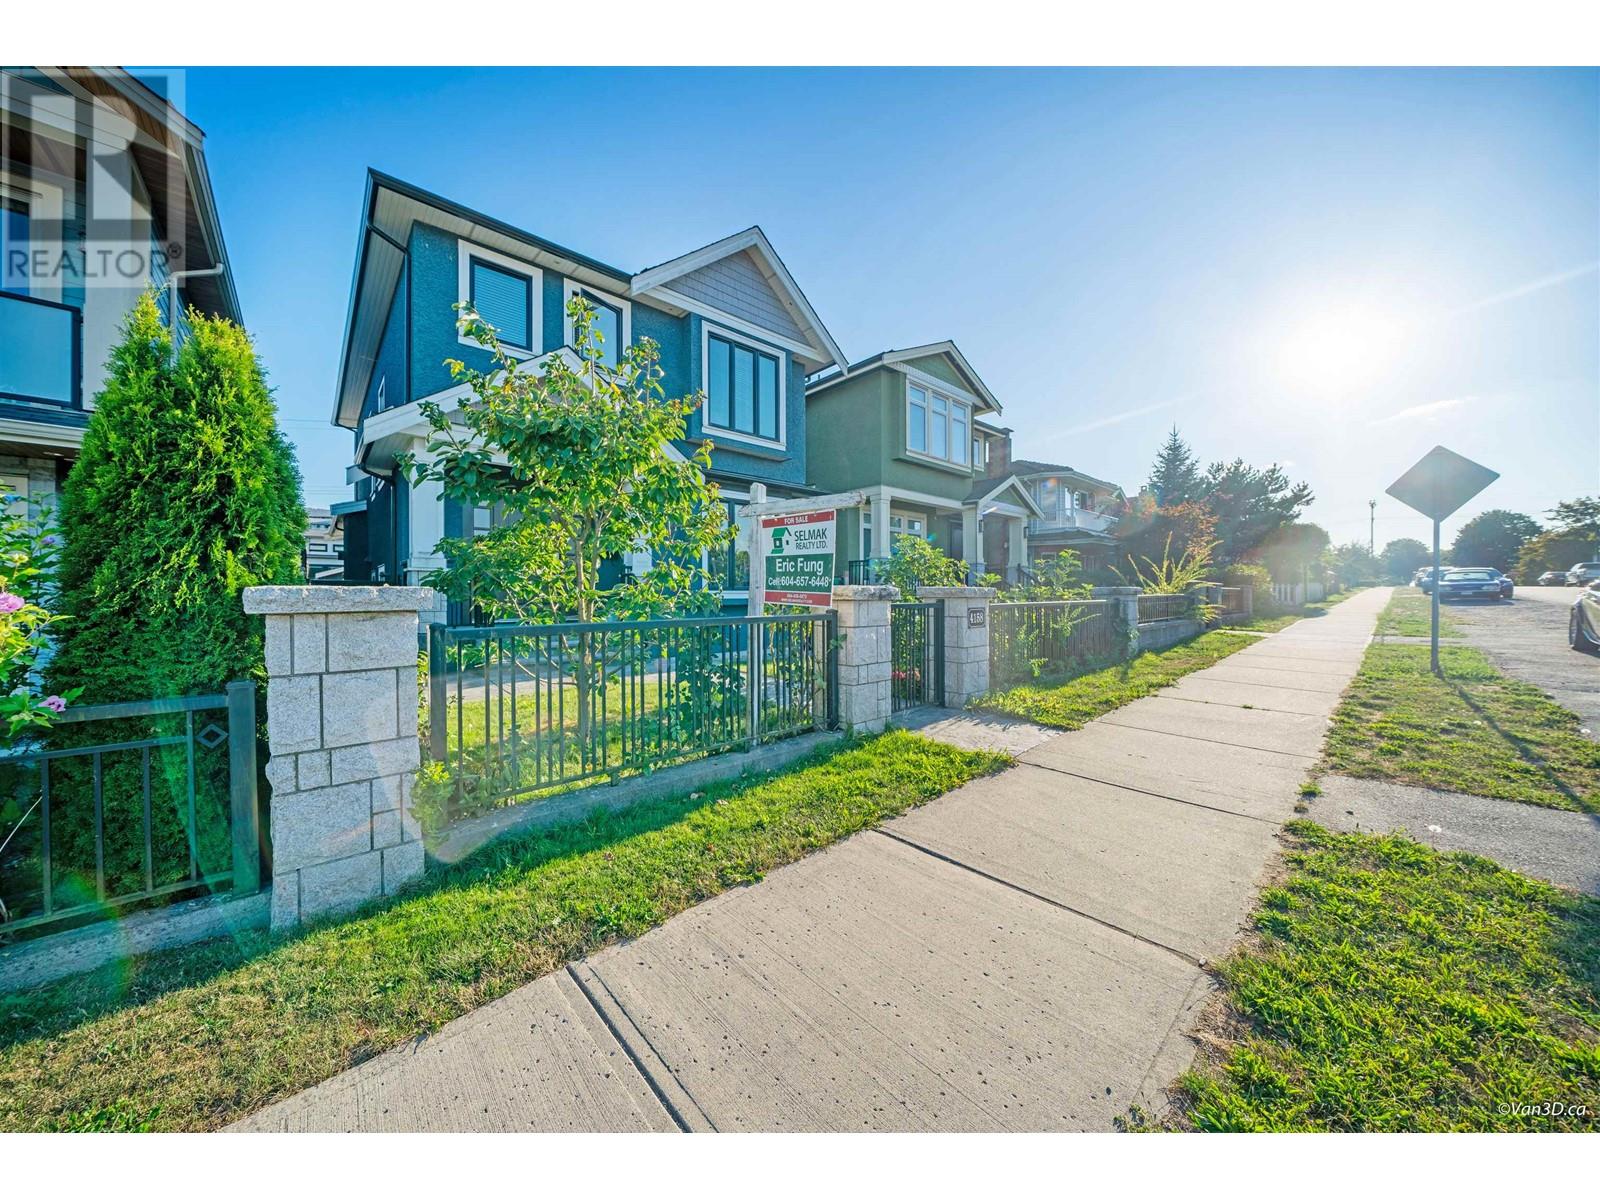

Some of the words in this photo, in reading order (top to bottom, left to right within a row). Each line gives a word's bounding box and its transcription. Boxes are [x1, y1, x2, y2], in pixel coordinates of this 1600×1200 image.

[794, 528, 828, 541] SELMAK
[795, 541, 815, 550] REALTY
[816, 541, 828, 549] LTD.
[775, 558, 795, 572] Eric
[797, 557, 824, 576] Fung
